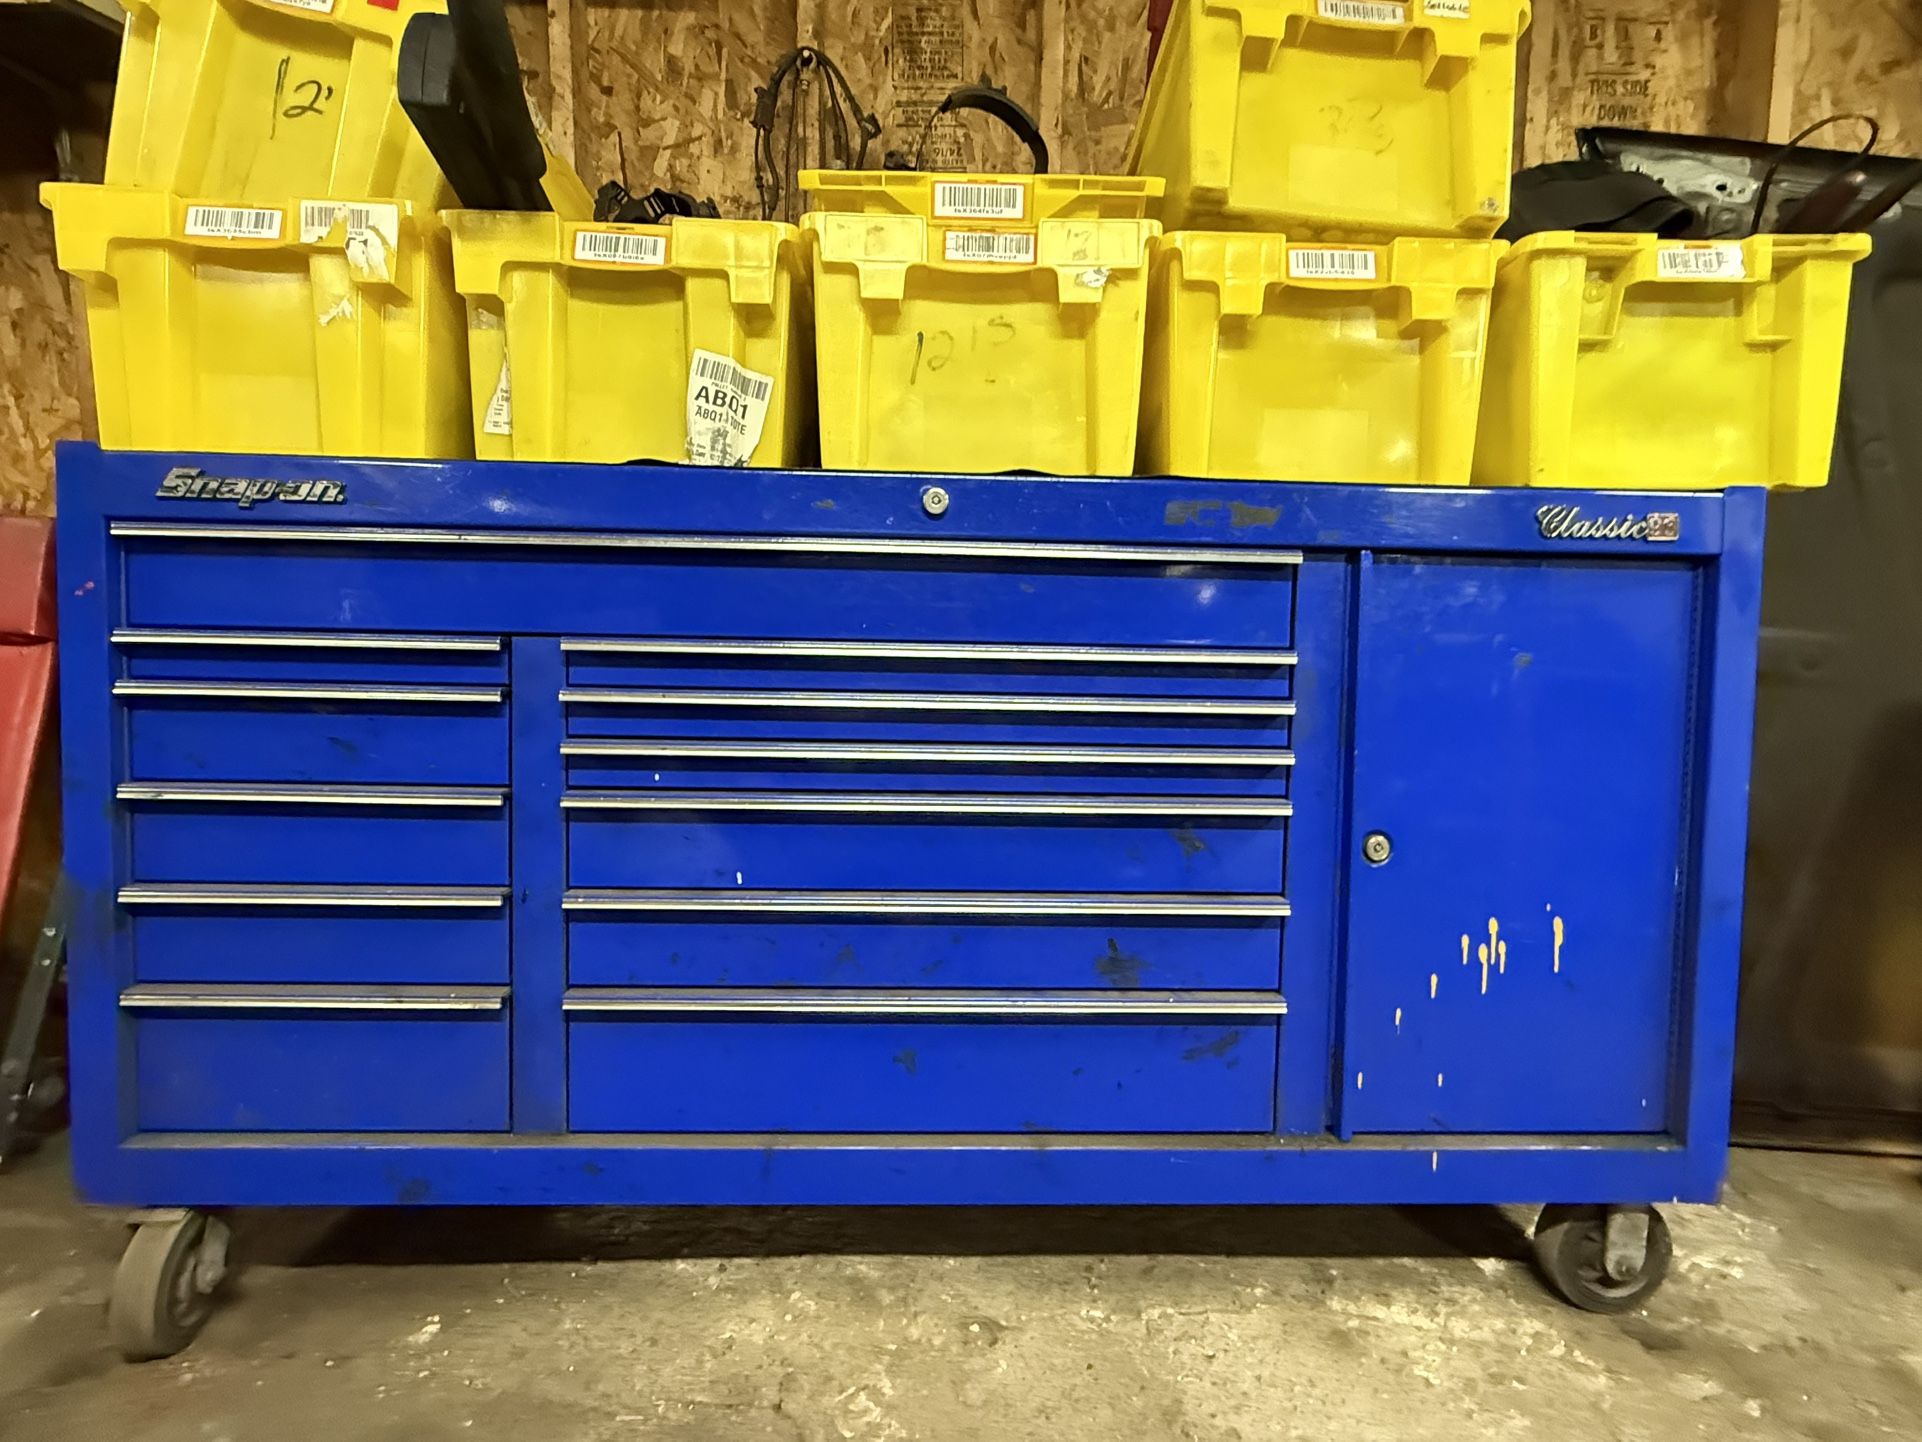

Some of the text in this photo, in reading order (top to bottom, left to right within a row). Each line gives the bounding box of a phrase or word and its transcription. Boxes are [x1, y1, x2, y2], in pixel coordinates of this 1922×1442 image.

[1588, 79, 1651, 97] THIS SIDE
[694, 385, 748, 420] ABQ1
[694, 405, 723, 423] ABQ1
[1537, 504, 1649, 538] Classic
